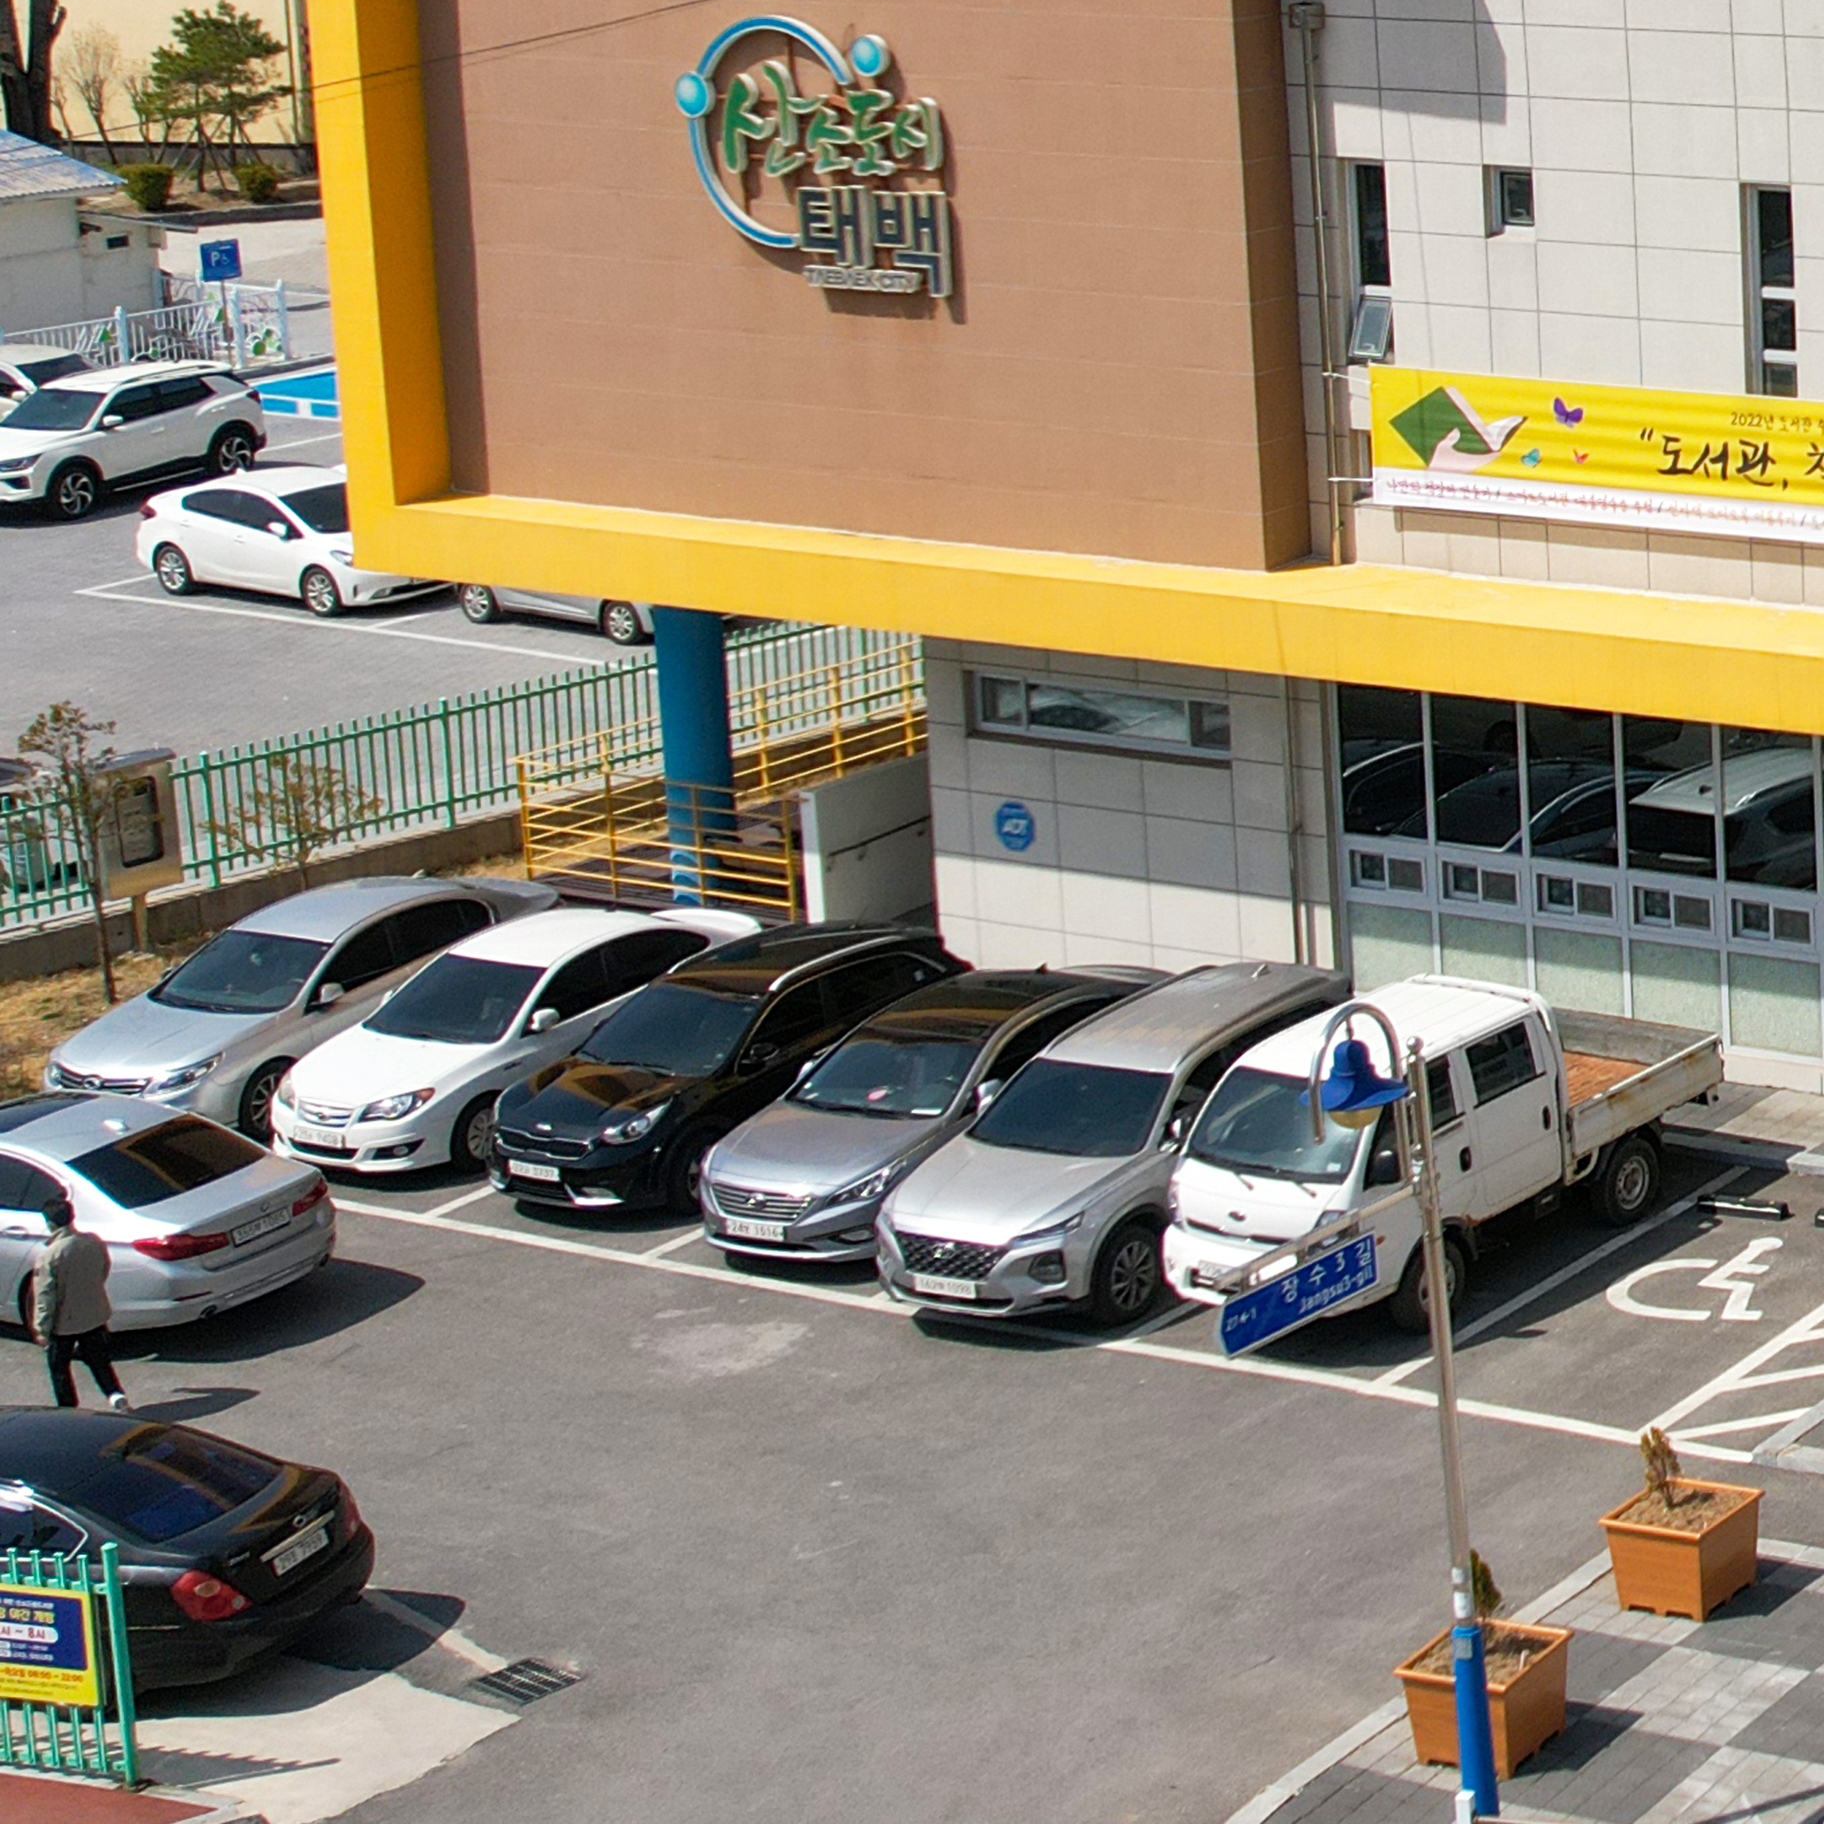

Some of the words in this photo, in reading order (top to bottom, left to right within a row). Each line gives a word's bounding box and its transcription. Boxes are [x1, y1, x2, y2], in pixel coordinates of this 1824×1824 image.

[797, 184, 952, 298] 태백
[1730, 410, 1774, 429] 2022년
[1298, 1265, 1374, 1315] Jangsu3-gil
